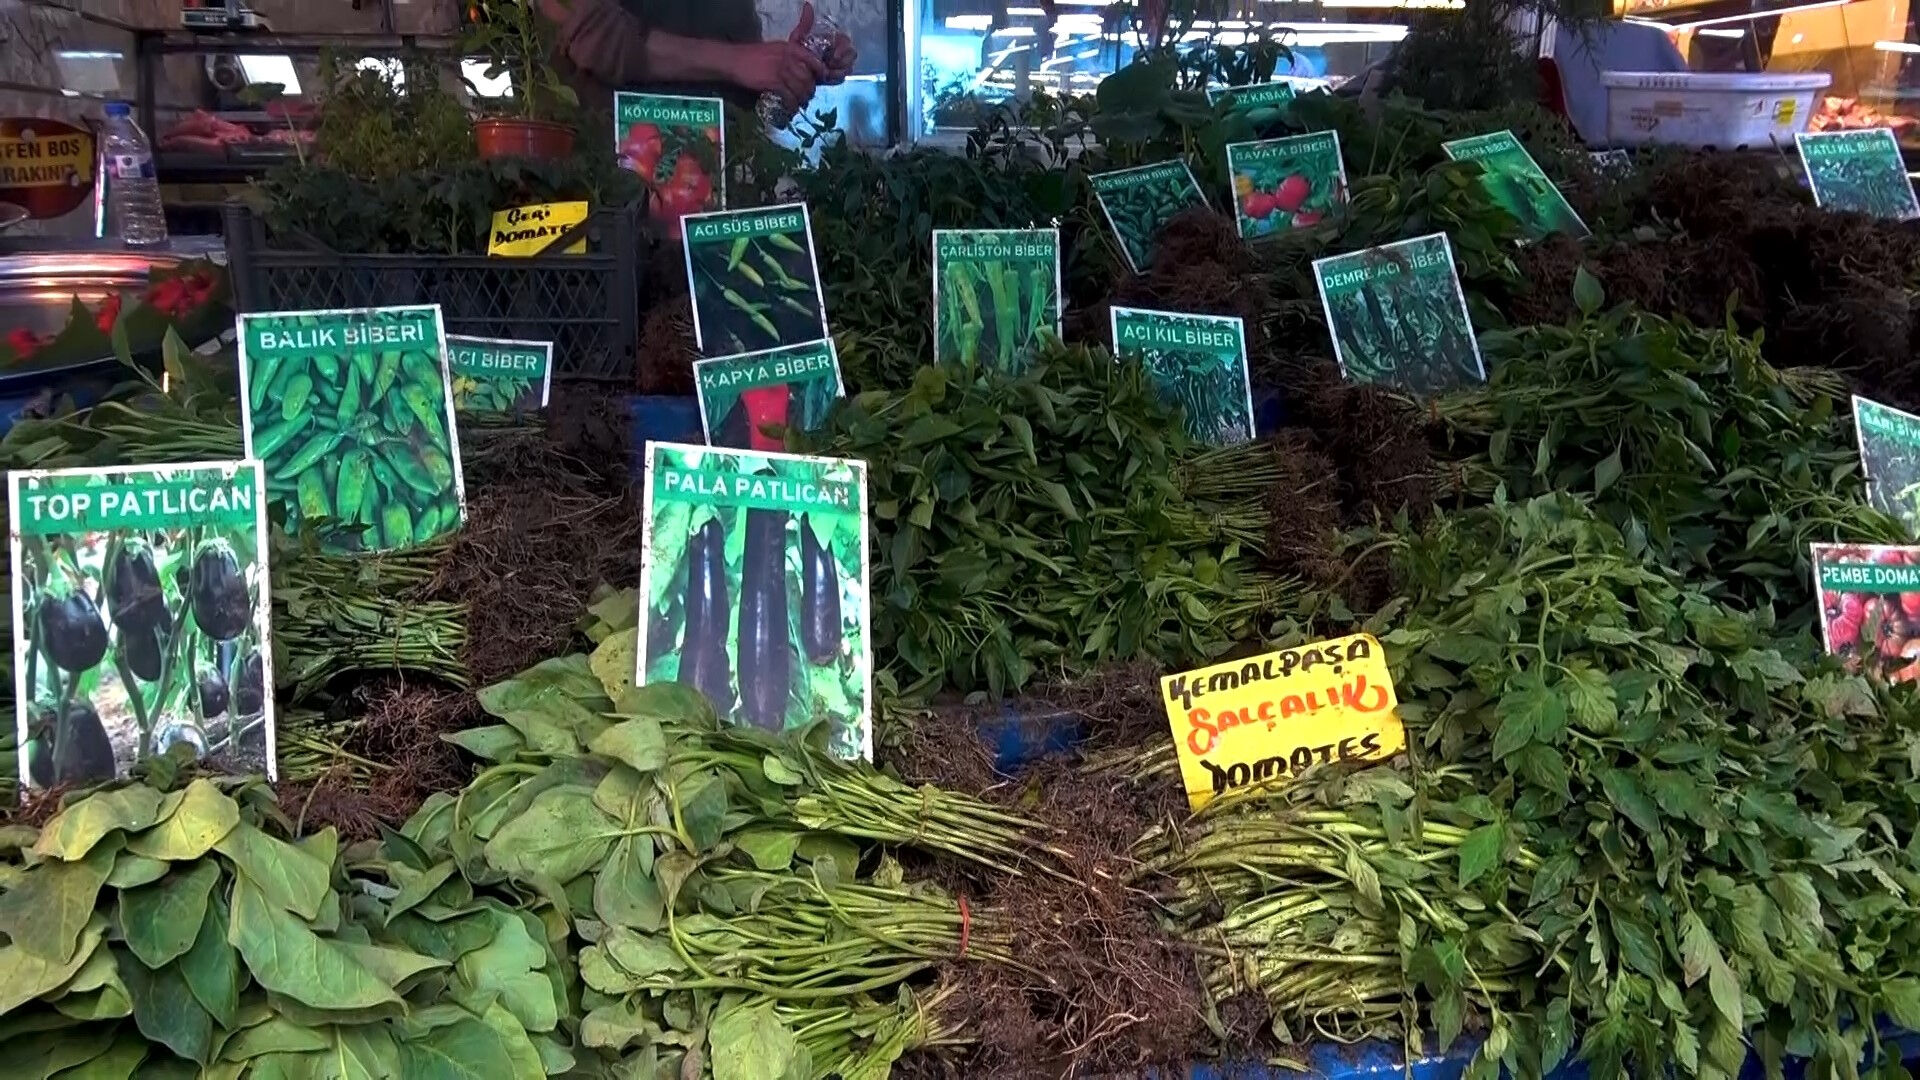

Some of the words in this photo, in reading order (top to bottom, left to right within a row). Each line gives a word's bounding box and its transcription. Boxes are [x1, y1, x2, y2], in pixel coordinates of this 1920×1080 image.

[624, 104, 649, 119] KÖY
[653, 109, 715, 122] DOMATESİ
[0, 142, 41, 158] FEN
[694, 223, 719, 238] ACI
[722, 214, 751, 234] SÜS
[754, 214, 798, 232] BİBER
[1014, 243, 1053, 257] BİBER
[1324, 266, 1374, 289] DEMRE
[1377, 262, 1400, 278] ACI
[260, 328, 337, 350] BALIK
[344, 319, 424, 346] BİBERİ
[1124, 324, 1150, 340] ACI
[1155, 326, 1182, 343] KIL
[1185, 327, 1234, 348] BİBER
[448, 349, 476, 366] ACI
[481, 350, 537, 371] BİBER
[703, 367, 770, 390] KAPYA
[775, 354, 831, 378] BİBER
[1863, 411, 1894, 433] SARI
[664, 471, 728, 497] PALA
[735, 477, 849, 507] PATLICAN
[27, 493, 91, 521] TOP
[100, 484, 251, 518] PATLICAN
[1822, 566, 1873, 585] PEMBE
[1875, 567, 1920, 585] DOMA
[1169, 638, 1371, 711] KEMALPAŞA
[1187, 674, 1389, 756] SALÇALIK
[1199, 732, 1382, 795] DOMATES
